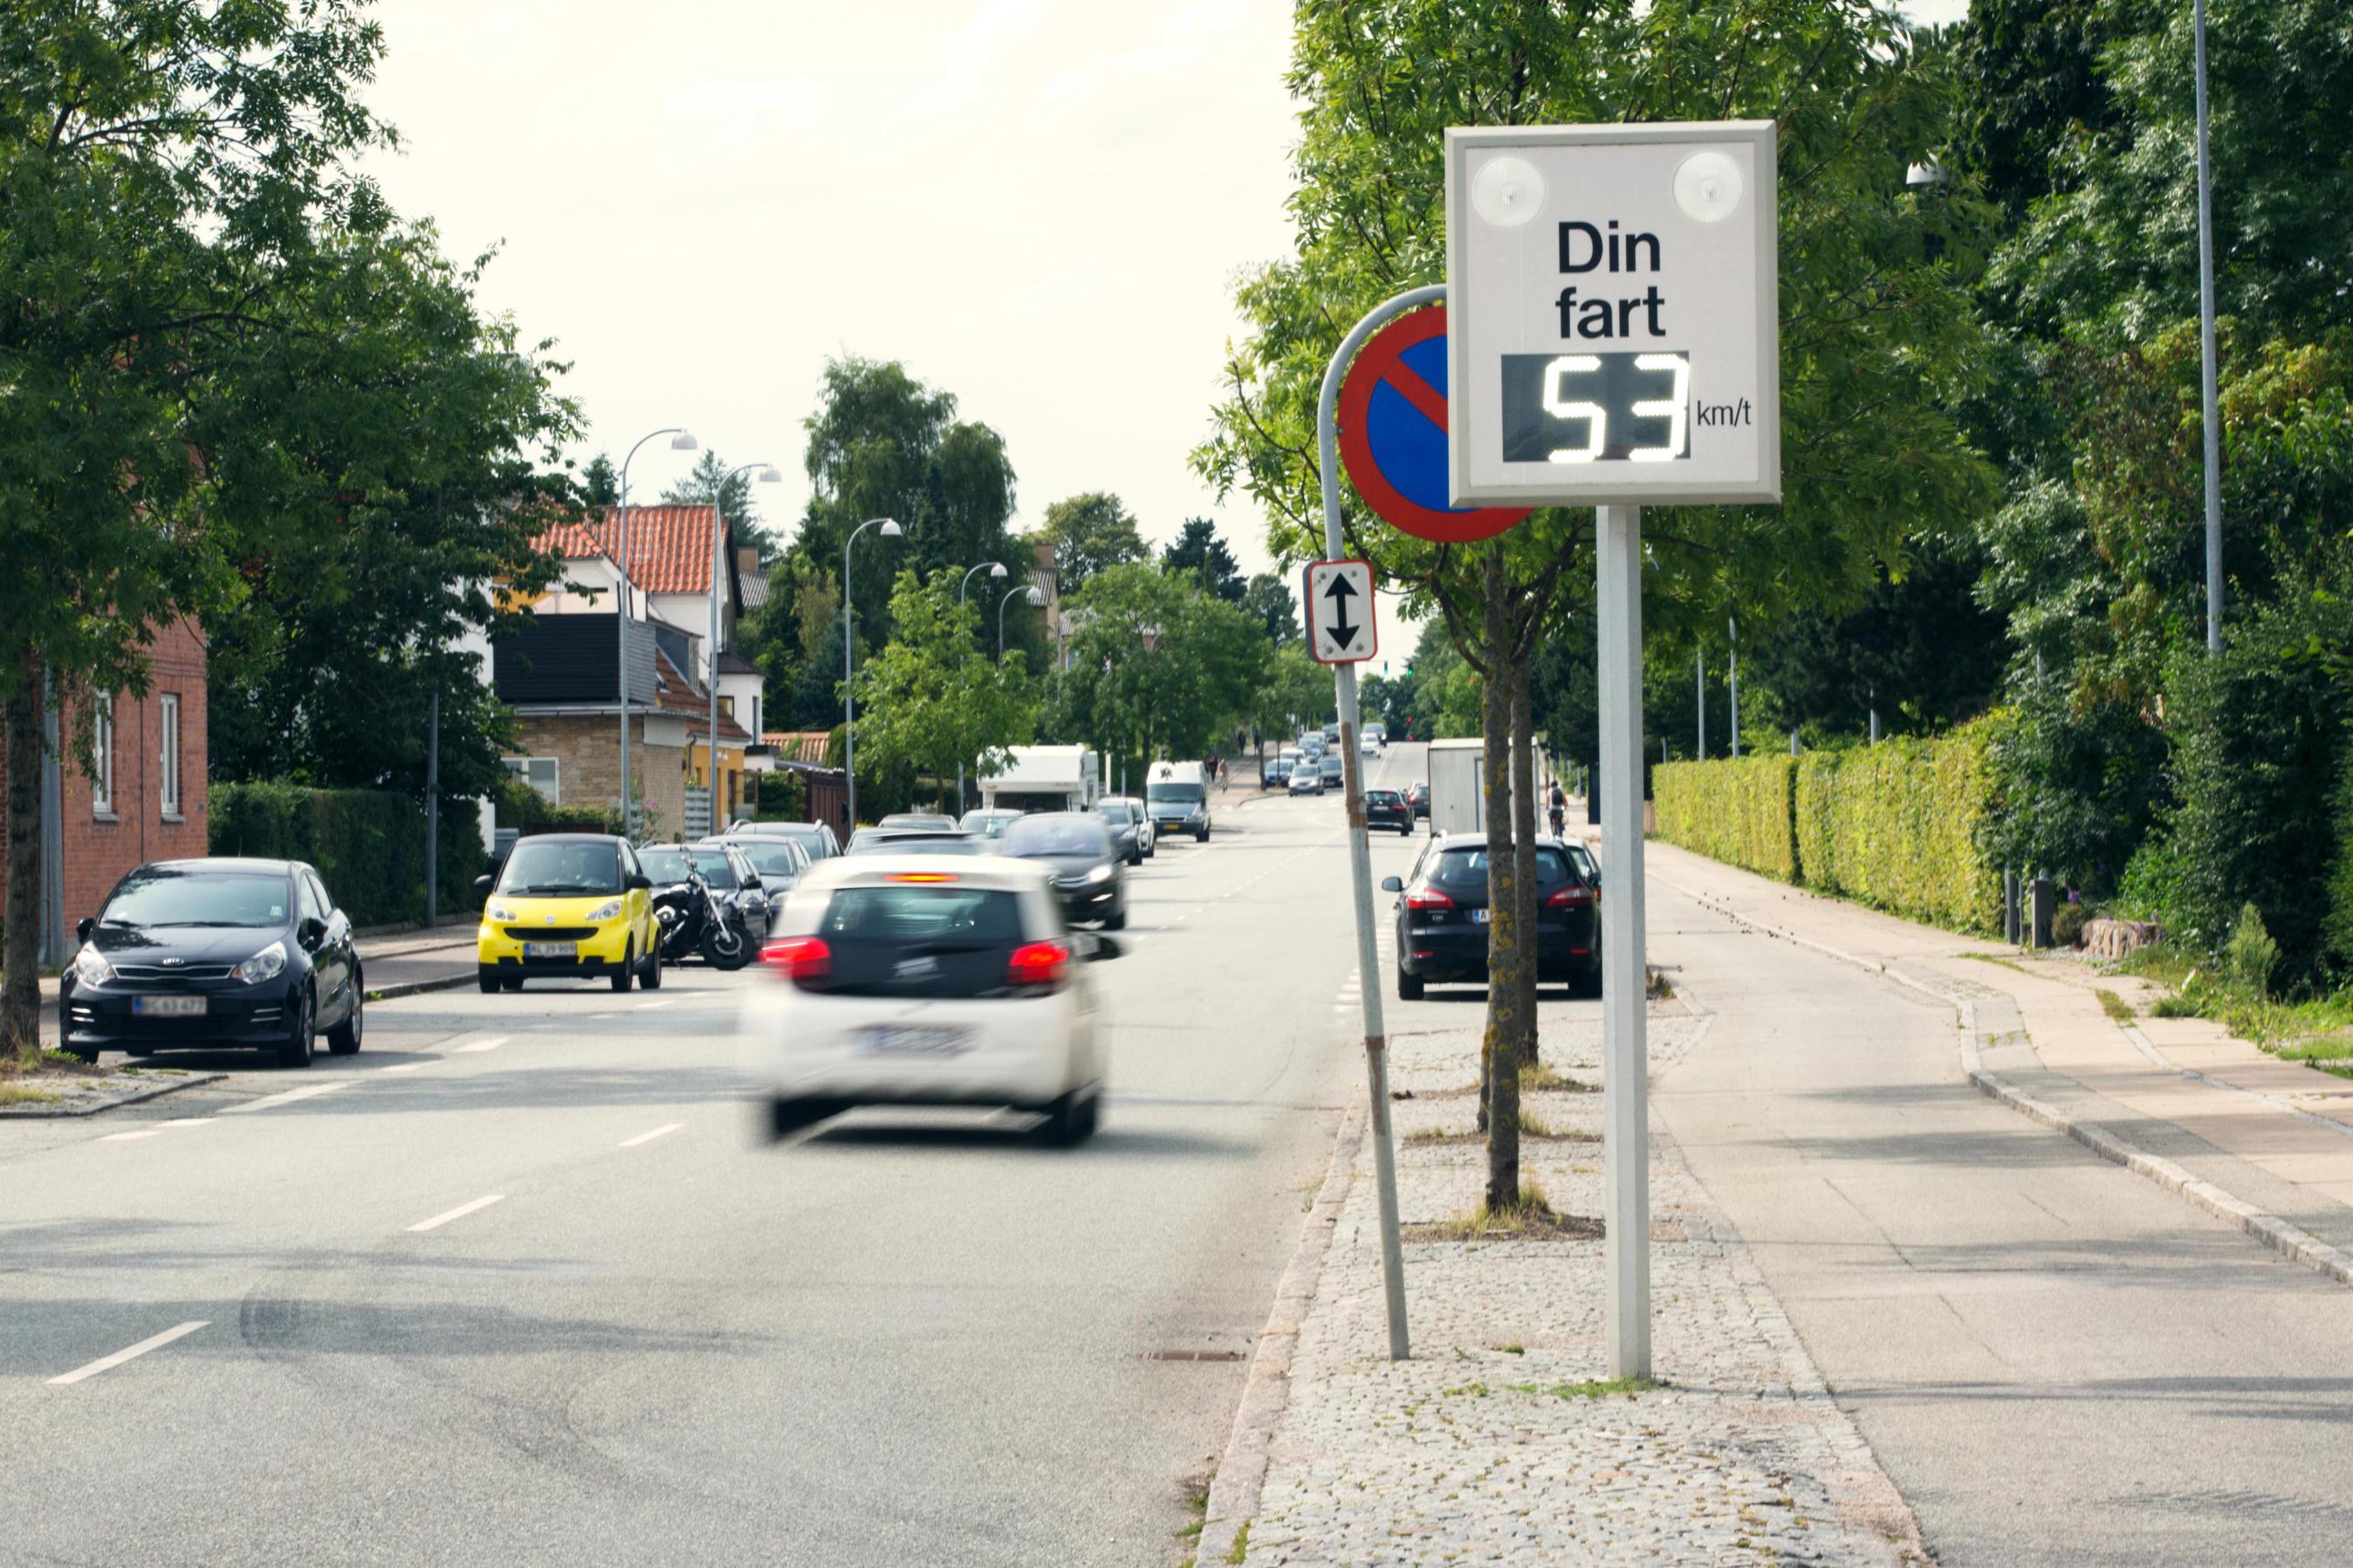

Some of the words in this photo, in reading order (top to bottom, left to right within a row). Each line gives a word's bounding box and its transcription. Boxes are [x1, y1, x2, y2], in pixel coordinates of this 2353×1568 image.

[1558, 220, 1661, 274] Din
[1555, 286, 1666, 339] fart
[1543, 353, 1690, 463] 53
[1697, 397, 1752, 427] km/t
